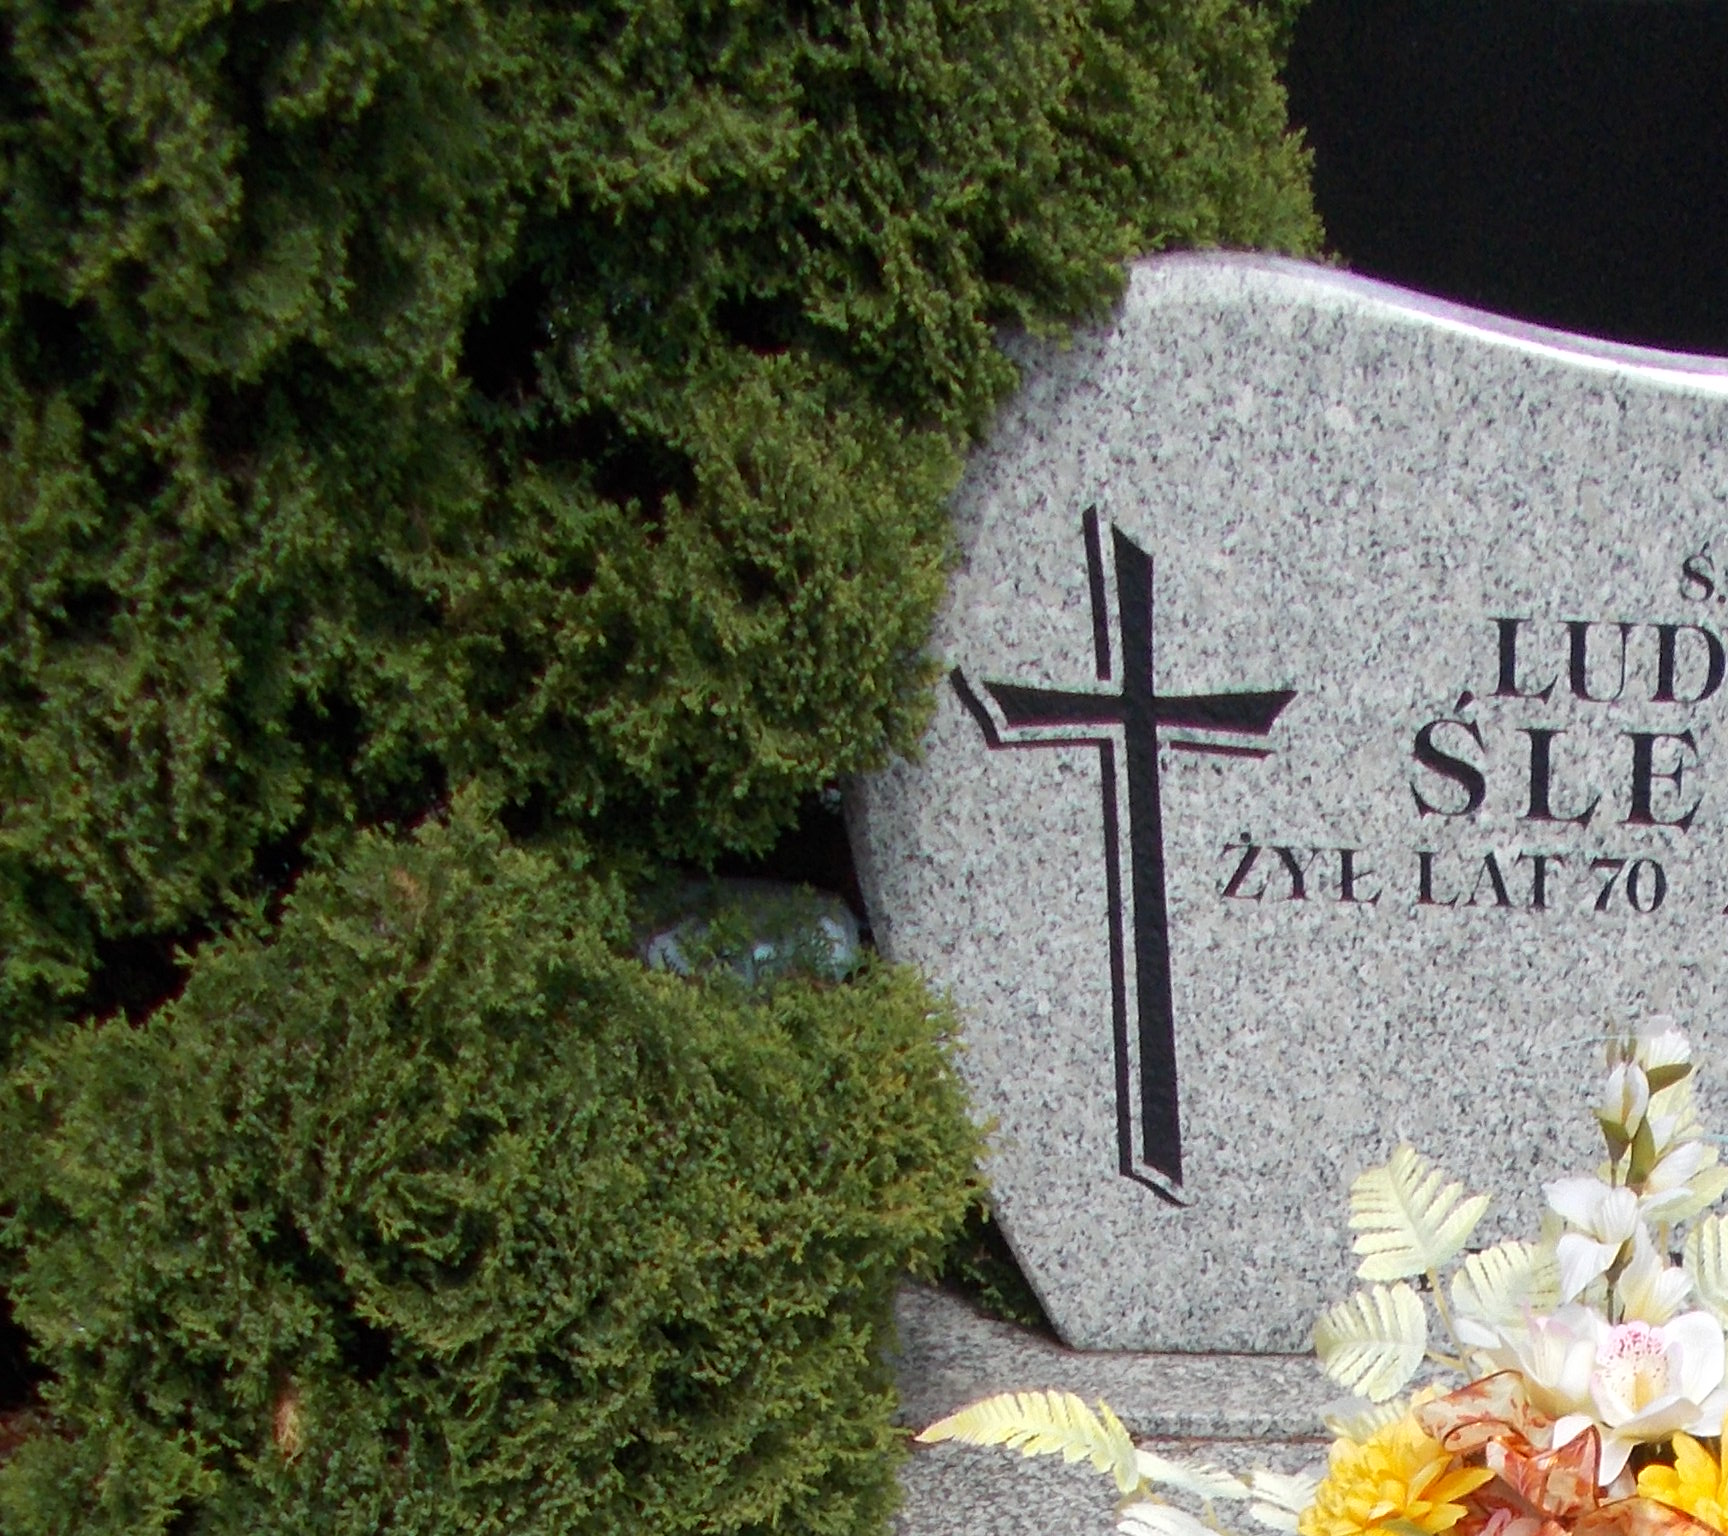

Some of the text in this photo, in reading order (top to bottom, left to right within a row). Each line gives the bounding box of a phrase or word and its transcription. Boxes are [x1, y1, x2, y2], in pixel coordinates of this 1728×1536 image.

[1221, 831, 1384, 905] ŻYŁ
[1414, 850, 1566, 910] LAT
[1589, 856, 1668, 914] 70
